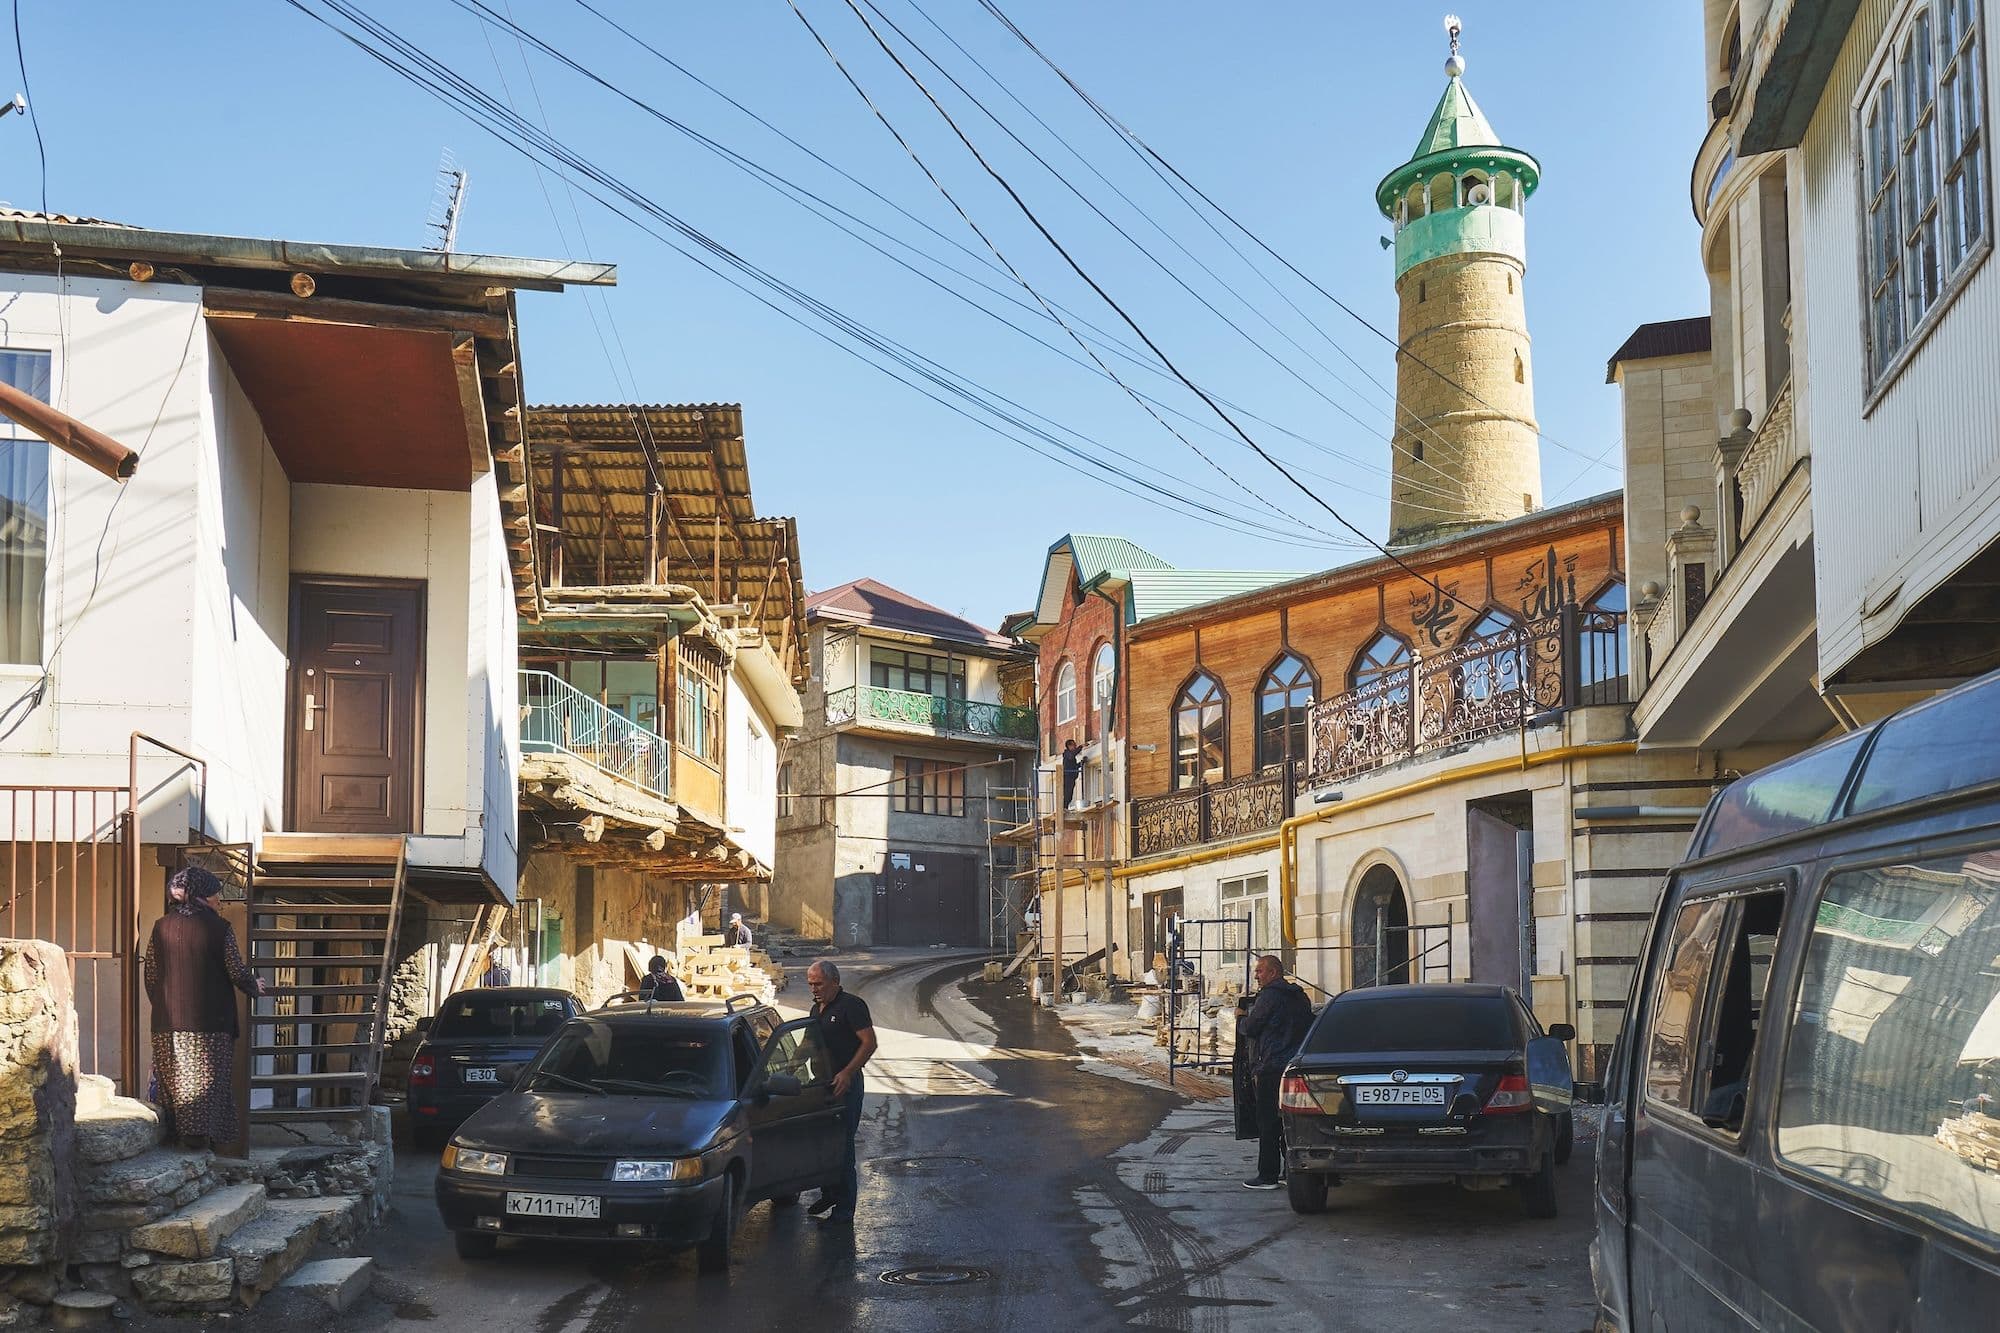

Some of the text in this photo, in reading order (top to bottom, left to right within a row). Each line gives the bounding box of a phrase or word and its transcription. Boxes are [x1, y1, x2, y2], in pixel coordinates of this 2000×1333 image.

[470, 1069, 497, 1080] Е307
[1424, 1088, 1439, 1099] 05
[580, 1199, 595, 1212] 71
